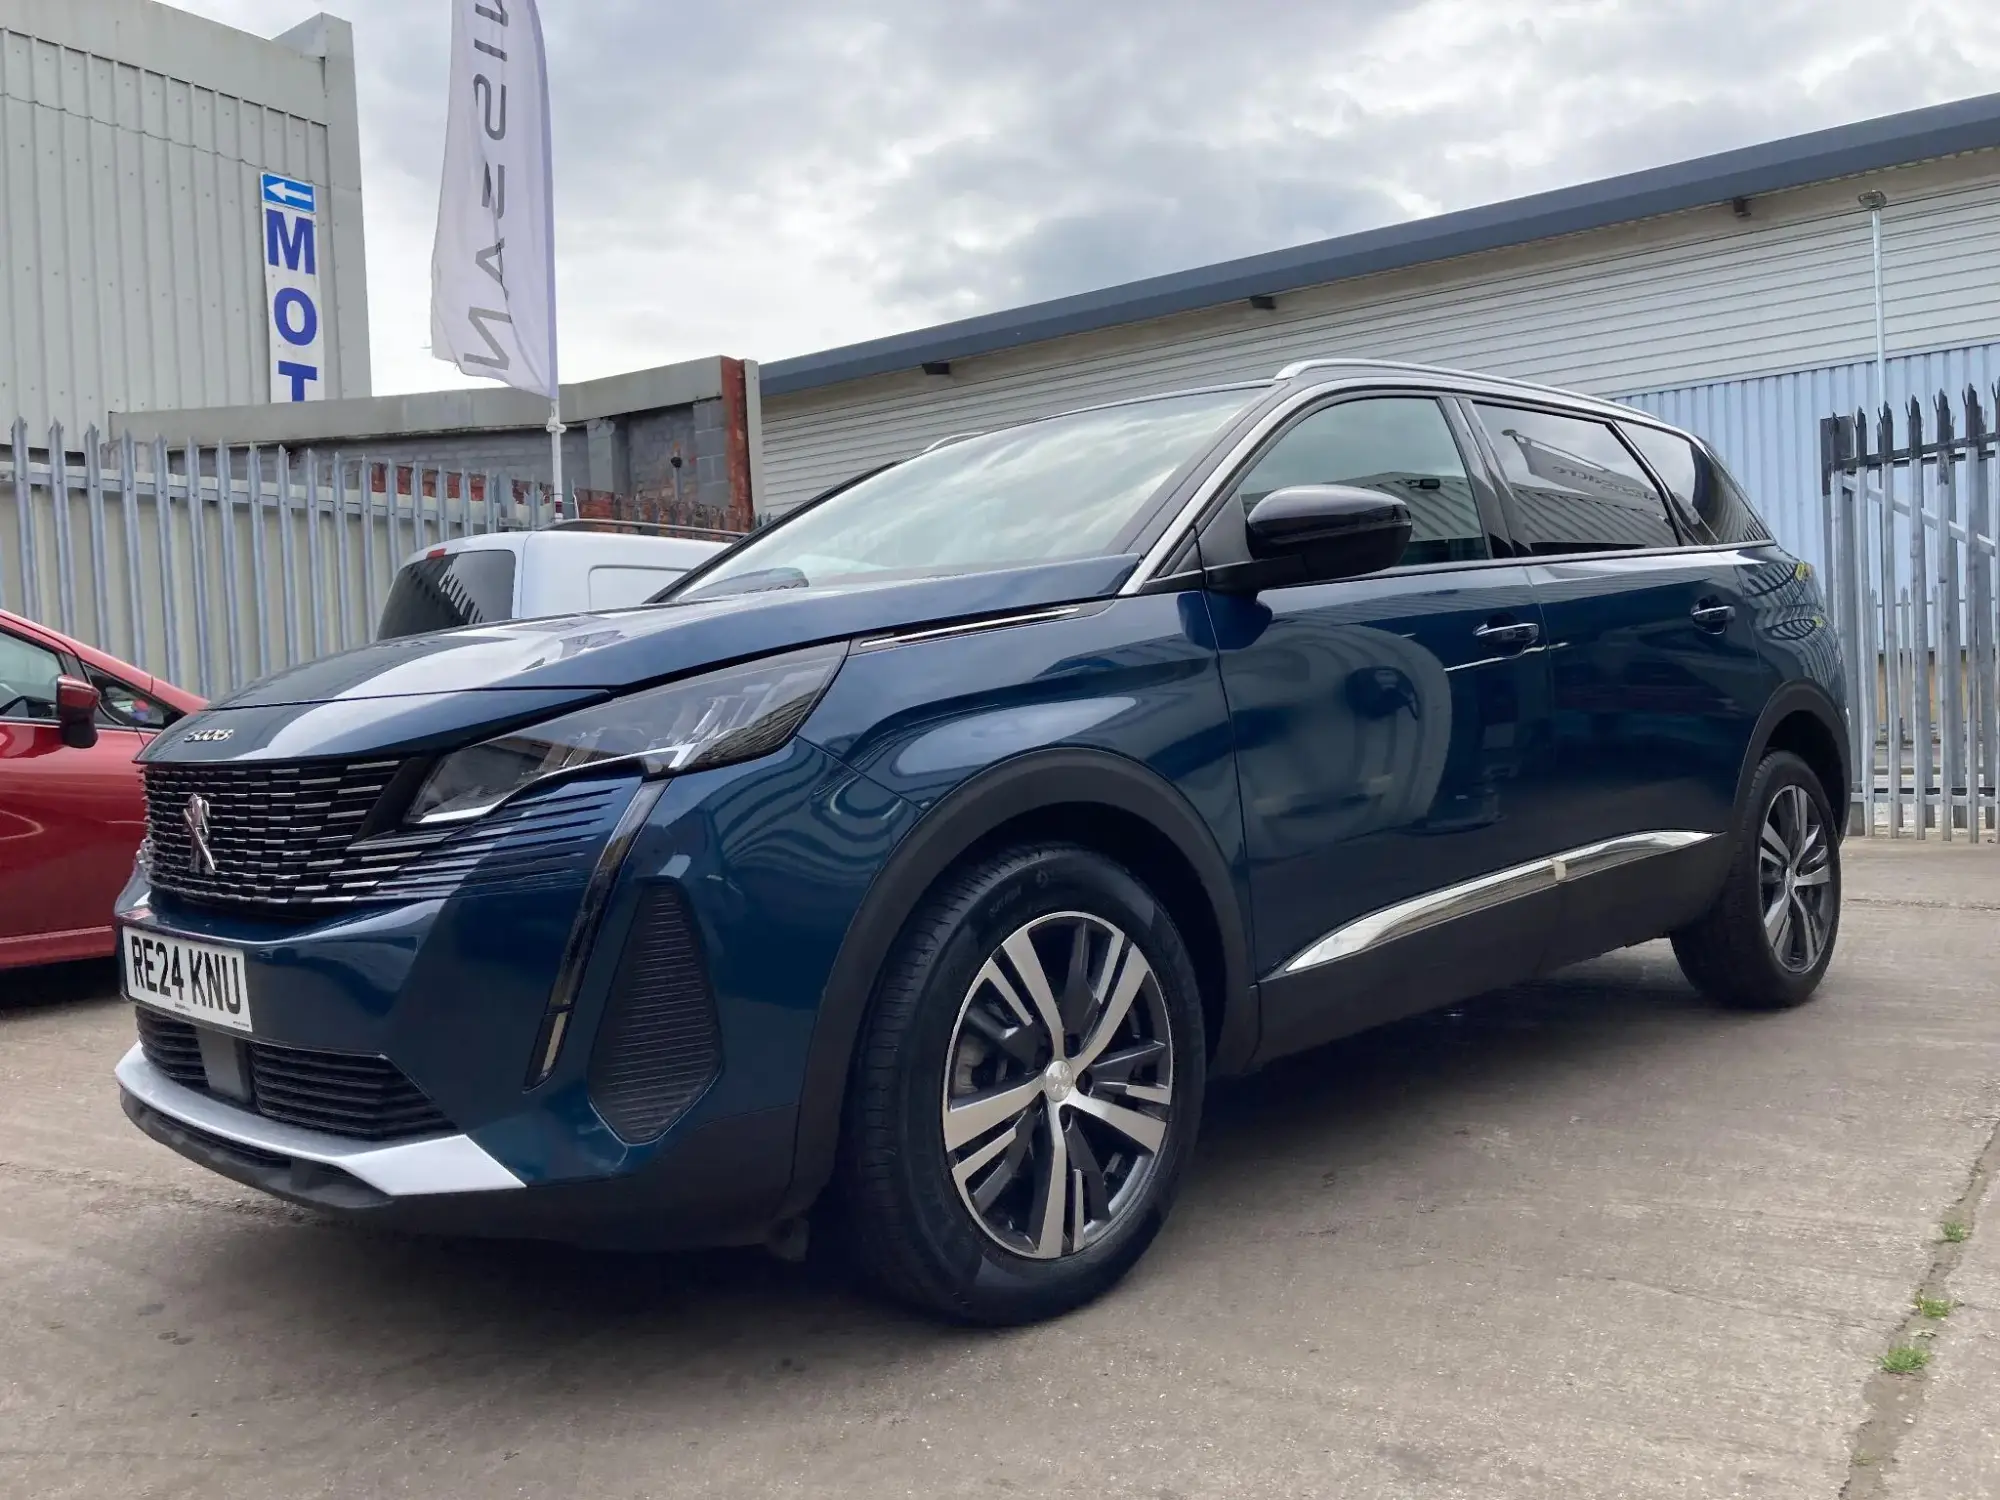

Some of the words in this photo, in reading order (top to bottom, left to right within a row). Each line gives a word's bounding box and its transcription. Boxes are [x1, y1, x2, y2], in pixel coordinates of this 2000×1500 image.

[266, 208, 317, 402] MOT
[131, 935, 184, 1001] RE24
[188, 948, 241, 1015] KNU
